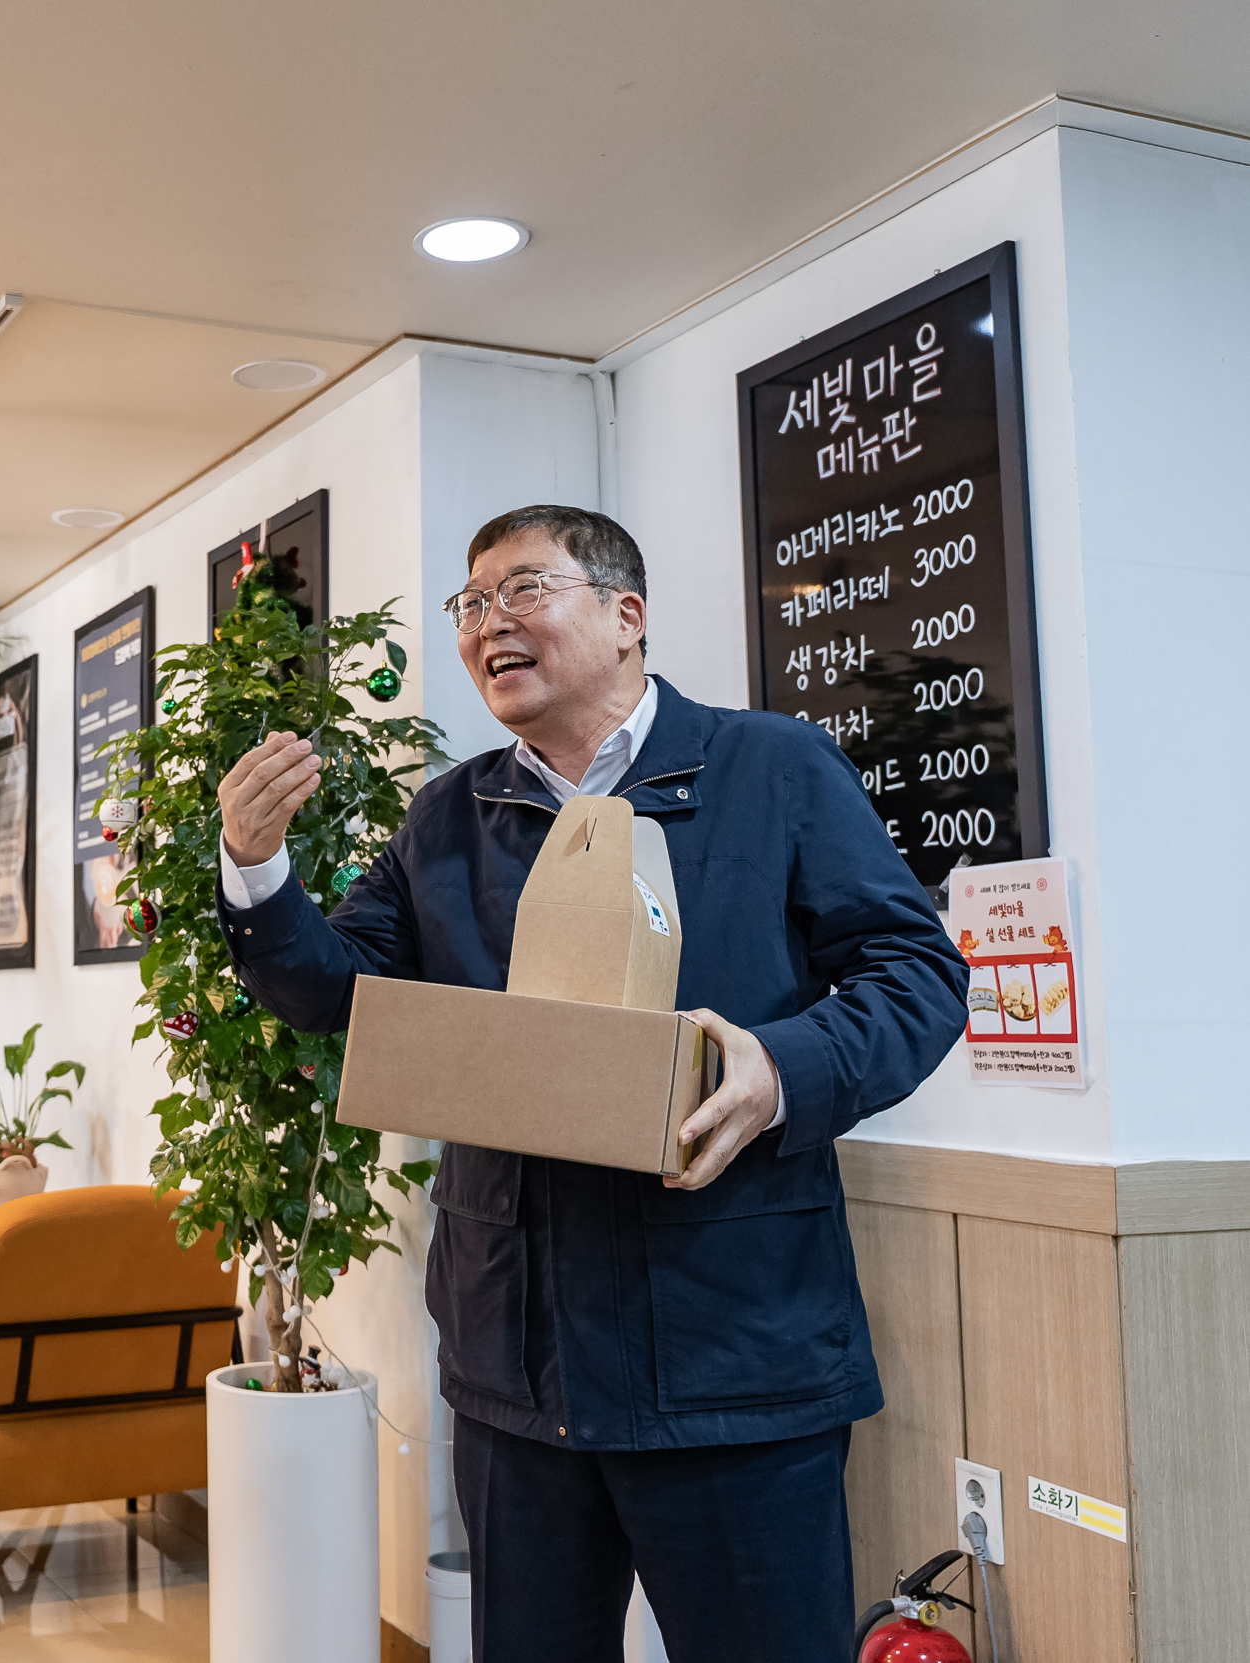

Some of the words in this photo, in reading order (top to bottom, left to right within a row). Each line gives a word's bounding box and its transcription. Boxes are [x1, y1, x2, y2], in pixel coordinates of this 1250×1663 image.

[817, 406, 922, 479] 메뉴판
[776, 503, 904, 566] 아메리카노
[912, 479, 974, 526] 2000
[781, 565, 890, 627] 카페라떼
[910, 533, 977, 588] 3000
[785, 634, 875, 691] 생강차
[911, 603, 976, 649] 2000
[913, 667, 984, 713] 2000
[919, 744, 990, 781] 2000
[921, 807, 996, 847] 2000
[999, 884, 1009, 893] 많이
[1011, 882, 1031, 892] 받으세요
[989, 900, 1024, 918] 세빛마을
[986, 927, 995, 943] 설
[998, 925, 1015, 942] 선물
[1018, 926, 1035, 938] 세트
[1032, 1483, 1078, 1516] 소화기
